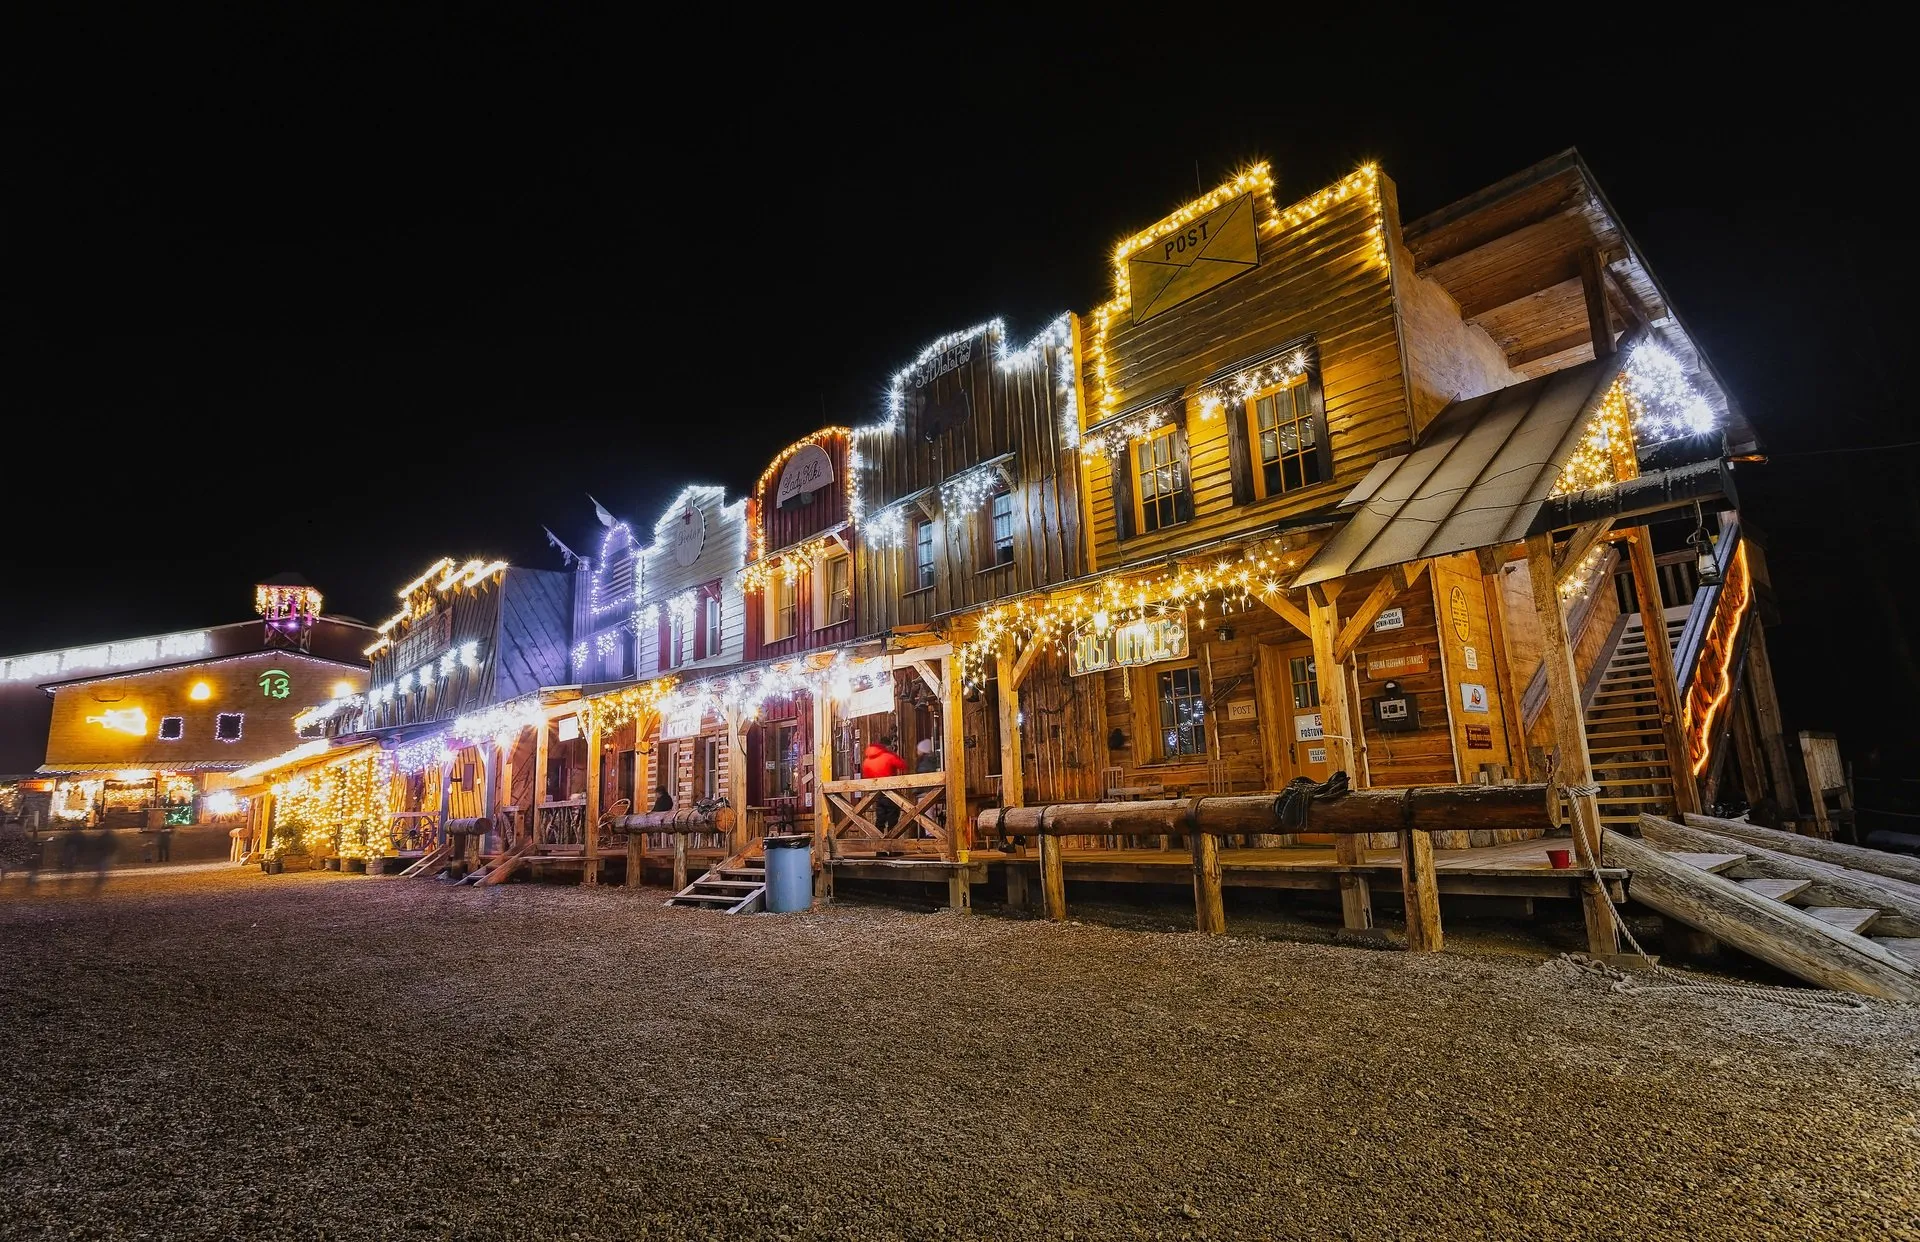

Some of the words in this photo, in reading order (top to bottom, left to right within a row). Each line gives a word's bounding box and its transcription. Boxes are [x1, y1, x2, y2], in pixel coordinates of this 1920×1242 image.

[1164, 220, 1210, 261] POST
[1379, 611, 1398, 619] RODEJ
[259, 678, 290, 699] 13
[1232, 704, 1252, 716] POST
[1300, 727, 1324, 738] POŠTOVN
